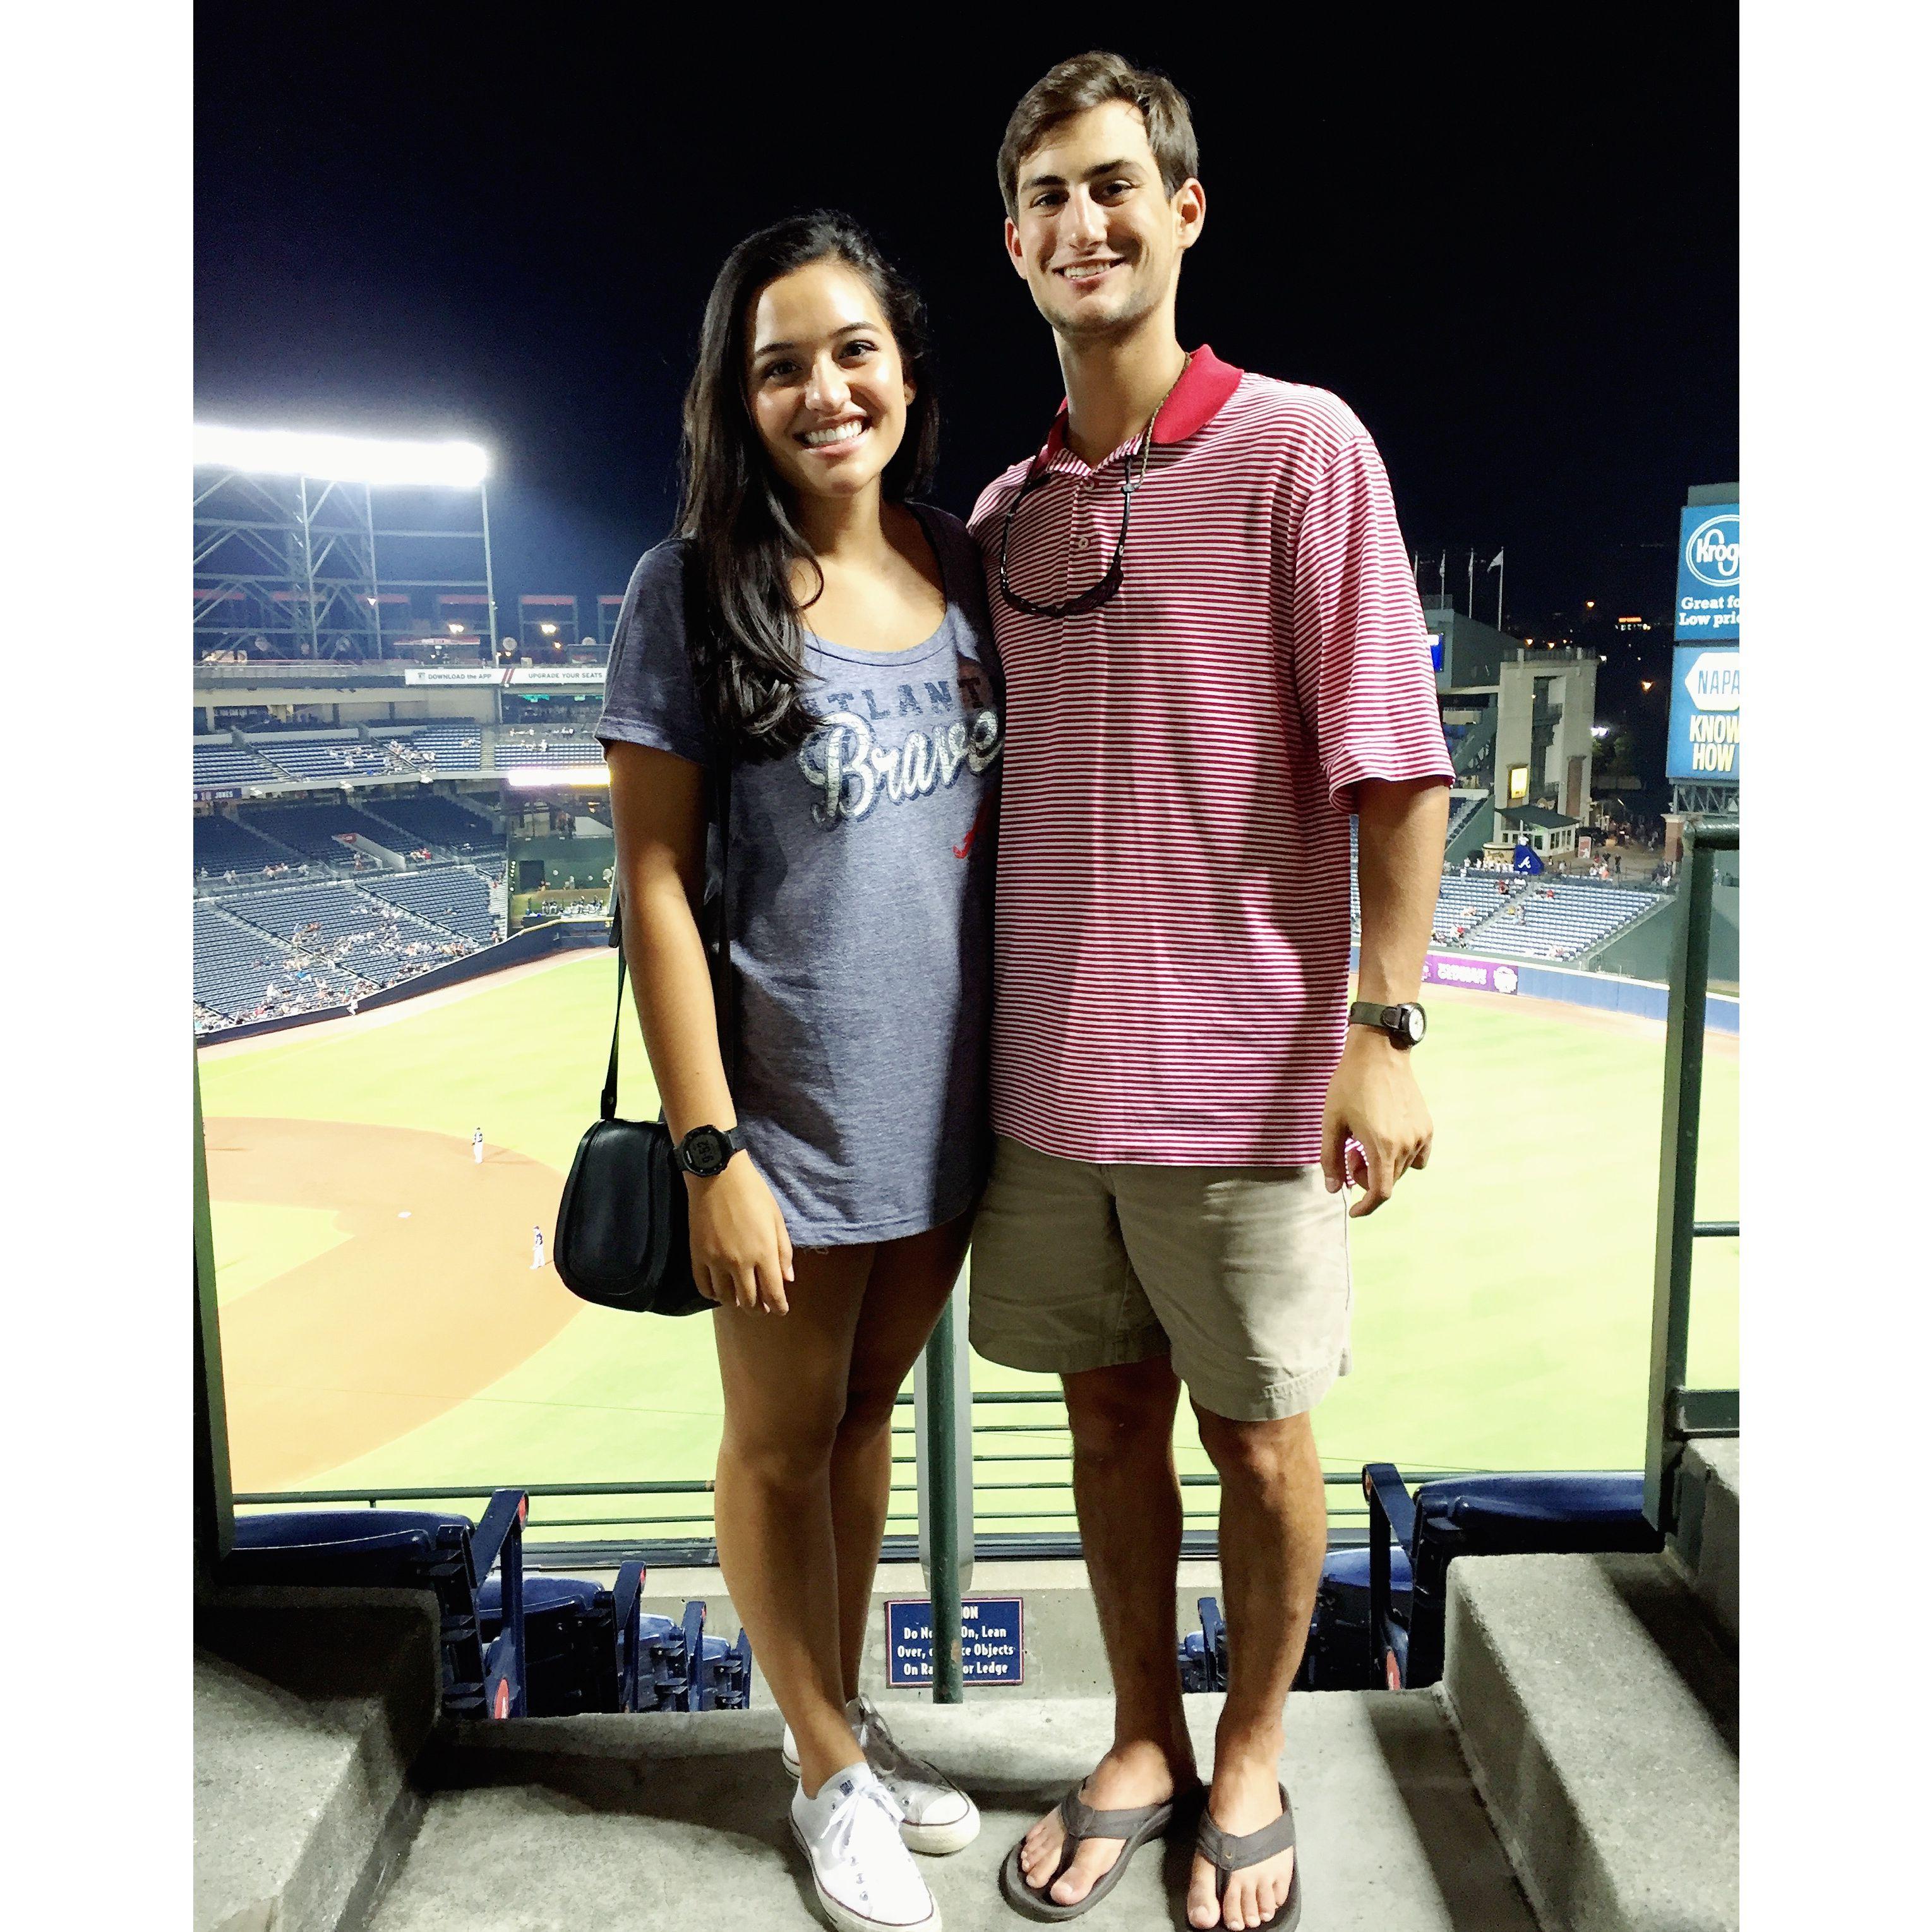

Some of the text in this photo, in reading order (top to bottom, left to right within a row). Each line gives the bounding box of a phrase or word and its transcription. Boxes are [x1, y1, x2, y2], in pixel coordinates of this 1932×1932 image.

[1696, 529, 1739, 576] Krog
[1681, 595, 1739, 610] Great fo
[1679, 611, 1739, 628] Low pri
[1698, 670, 1739, 694] NAPA
[1689, 714, 1739, 743] KNOW
[1692, 743, 1735, 772] HOW
[798, 709, 1005, 829] Brave
[904, 1626, 1007, 1640] Do No On, Lean
[897, 1645, 926, 1659] Over,
[974, 1643, 1014, 1658] Objects
[904, 1663, 918, 1675] On
[963, 1664, 974, 1674] or
[976, 1662, 1008, 1676] Ledge
